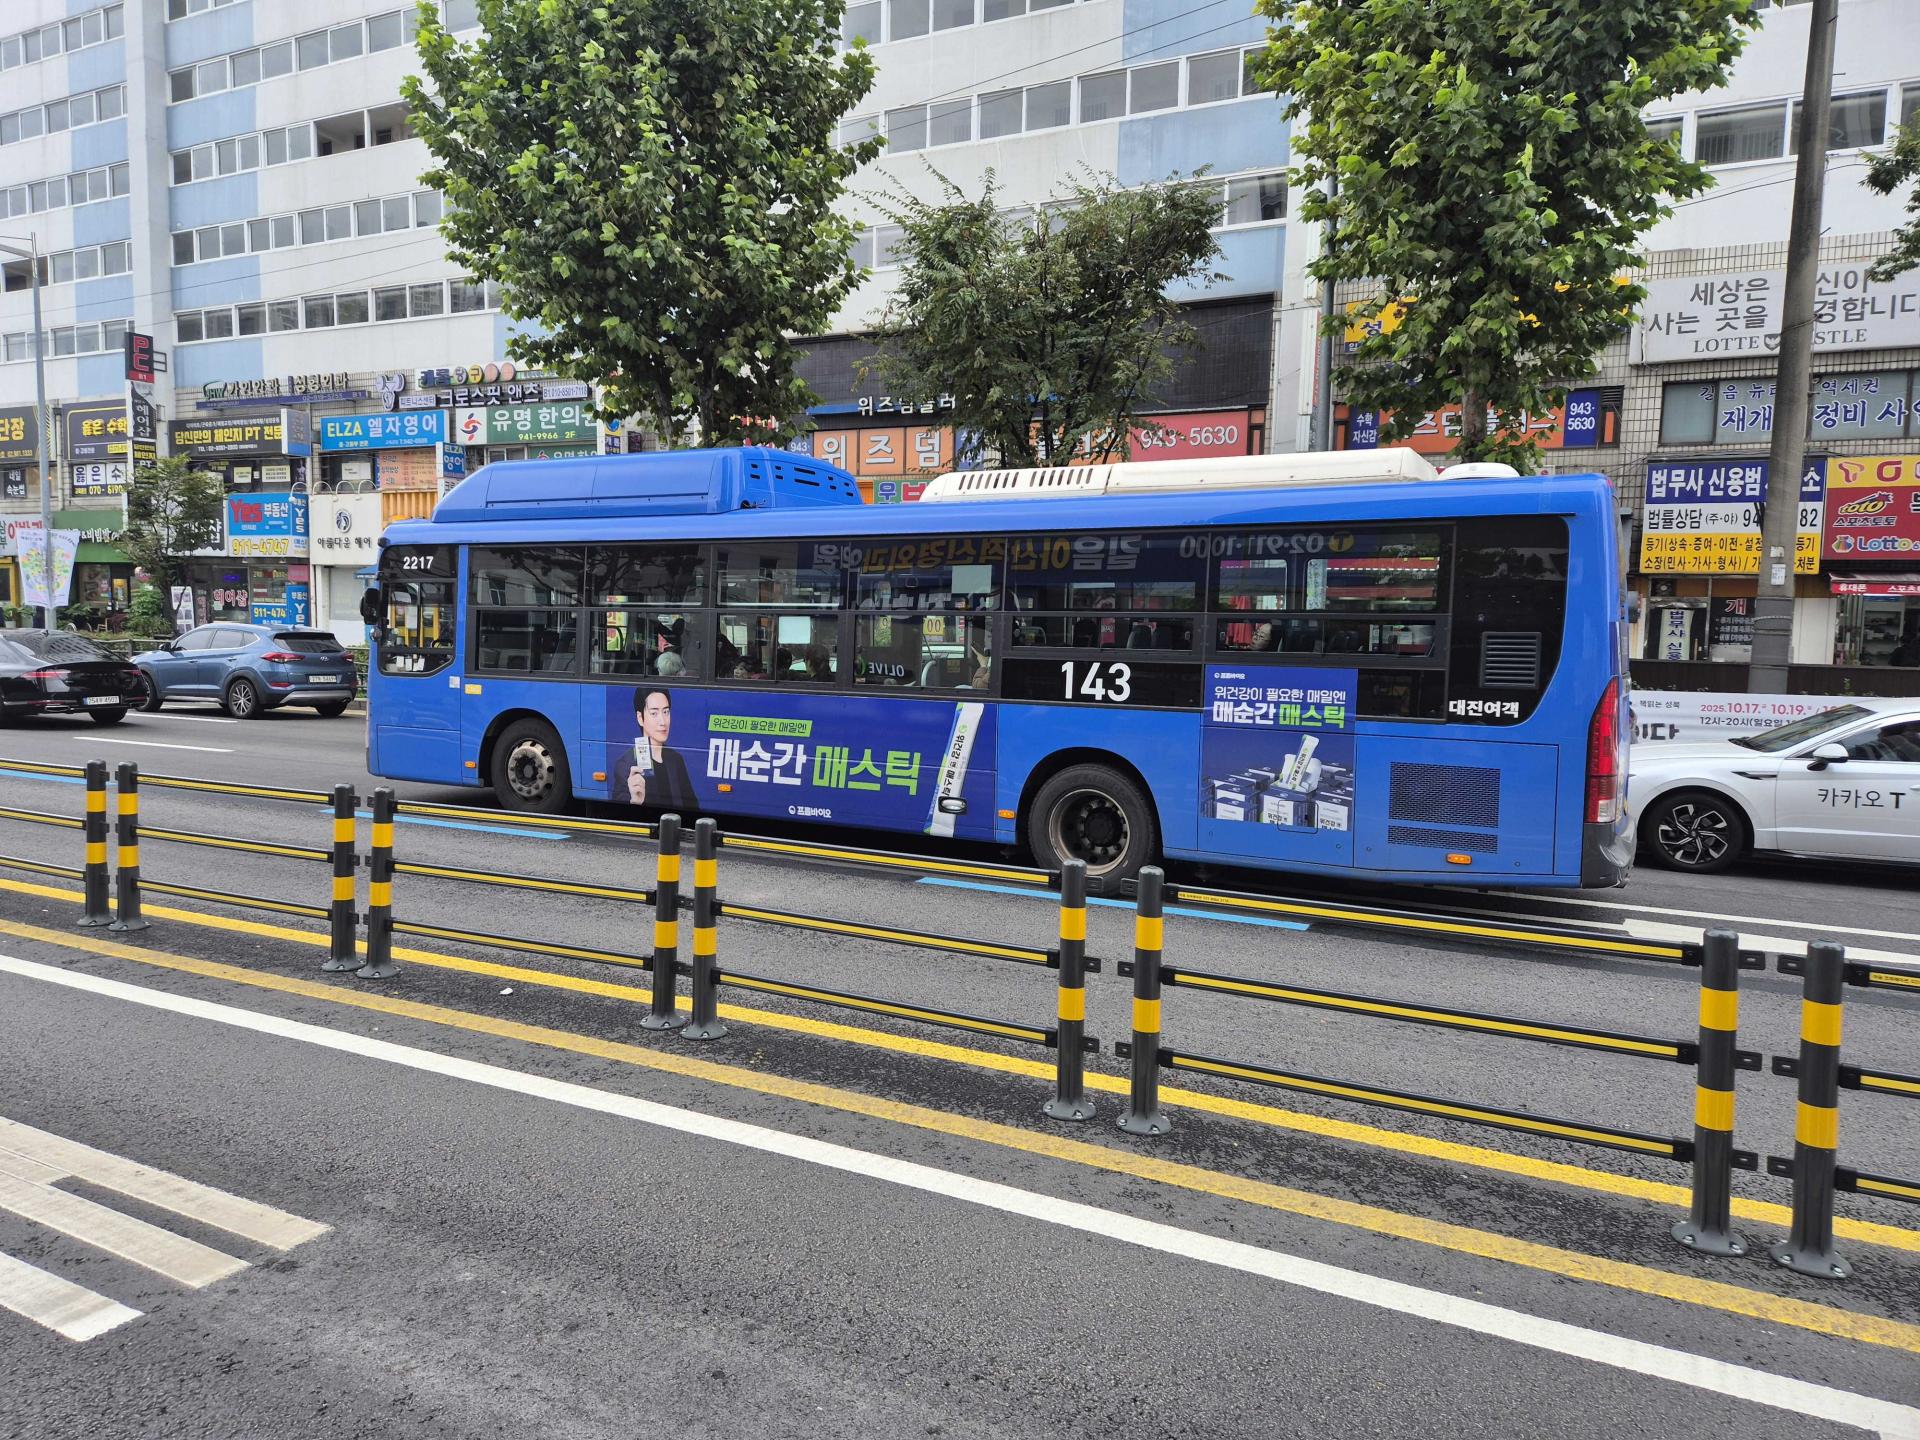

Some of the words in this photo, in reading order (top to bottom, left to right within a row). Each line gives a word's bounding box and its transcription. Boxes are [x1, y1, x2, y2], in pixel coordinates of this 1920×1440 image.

[1690, 277, 1769, 305] 세상은
[1649, 311, 1699, 335] 사는
[1715, 305, 1768, 332] 곳을
[1694, 335, 1760, 353] LOTTE
[1814, 329, 1867, 345] STLE
[133, 336, 149, 372] PC
[294, 372, 350, 394] 성형외과
[1822, 378, 1879, 396] 역세권
[440, 385, 501, 407] 크로스핏
[507, 383, 540, 404] 앤츠
[492, 407, 532, 431] 유명
[1356, 413, 1373, 427] 수학
[1567, 417, 1595, 430] 5630
[1815, 400, 1867, 428] 정비
[175, 430, 211, 445] 당신만의
[245, 427, 260, 440] PT
[327, 421, 363, 438] ELZA
[367, 413, 437, 438] 엘자영어
[518, 432, 558, 441] 941-9966
[564, 431, 576, 440] 2F
[1352, 429, 1377, 444] 자신감
[819, 431, 941, 470] 위즈덤
[444, 455, 464, 471] 영어
[1651, 467, 1704, 498] 법무사
[1708, 466, 1762, 497] 신용범
[231, 500, 262, 523] Yes
[264, 502, 288, 518] 부동산
[295, 508, 306, 533] Yes
[1648, 508, 1702, 530] 법률상담
[1833, 516, 1897, 527] 스포츠토토
[232, 538, 289, 556] 911-4747
[317, 536, 351, 549] 아름다운
[355, 536, 371, 549] 헤어
[1858, 536, 1912, 551] Lotto
[402, 556, 434, 570] 2217
[1668, 610, 1685, 638] 법무사
[1062, 661, 1131, 702] 143
[1214, 686, 1262, 701] 위건강이
[1266, 688, 1303, 703] 필요한
[1307, 690, 1346, 705] 매일엔
[1664, 701, 1681, 709] 성북
[1212, 701, 1276, 725] 매순간
[1279, 703, 1345, 729] 매스틱
[1448, 699, 1519, 718] 대진여객
[713, 717, 747, 730] 위건강이
[750, 721, 777, 732] 필요한
[951, 735, 965, 760] 위건강
[706, 738, 807, 786] 매순간
[812, 745, 921, 796] 매스틱
[1817, 788, 1884, 808] 카카오
[1889, 792, 1906, 809] T
